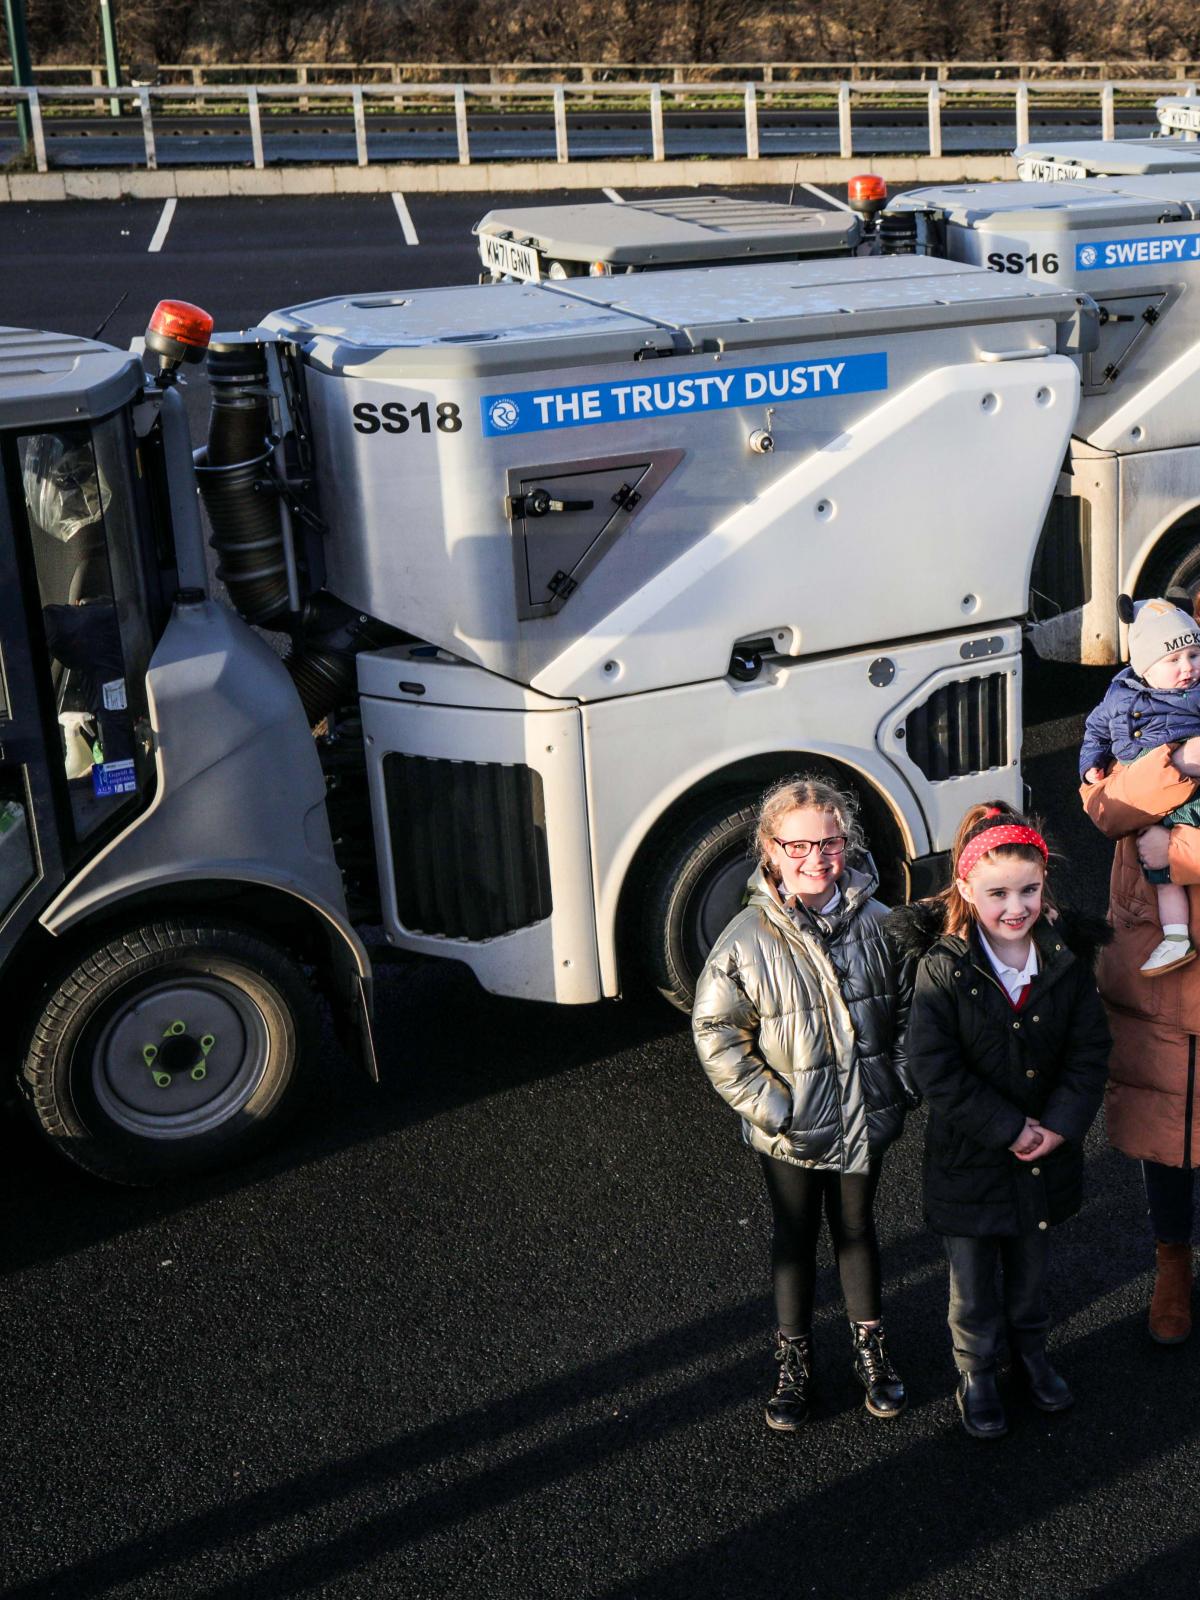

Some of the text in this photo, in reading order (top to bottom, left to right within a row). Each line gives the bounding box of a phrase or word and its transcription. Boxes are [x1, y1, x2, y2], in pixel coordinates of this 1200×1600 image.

[987, 252, 1060, 274] SS16
[1105, 240, 1186, 264] SWEEPY
[533, 390, 602, 424] THE
[611, 375, 736, 415] TRUSTY
[745, 362, 846, 400] DUSTY
[352, 401, 463, 434] SS18
